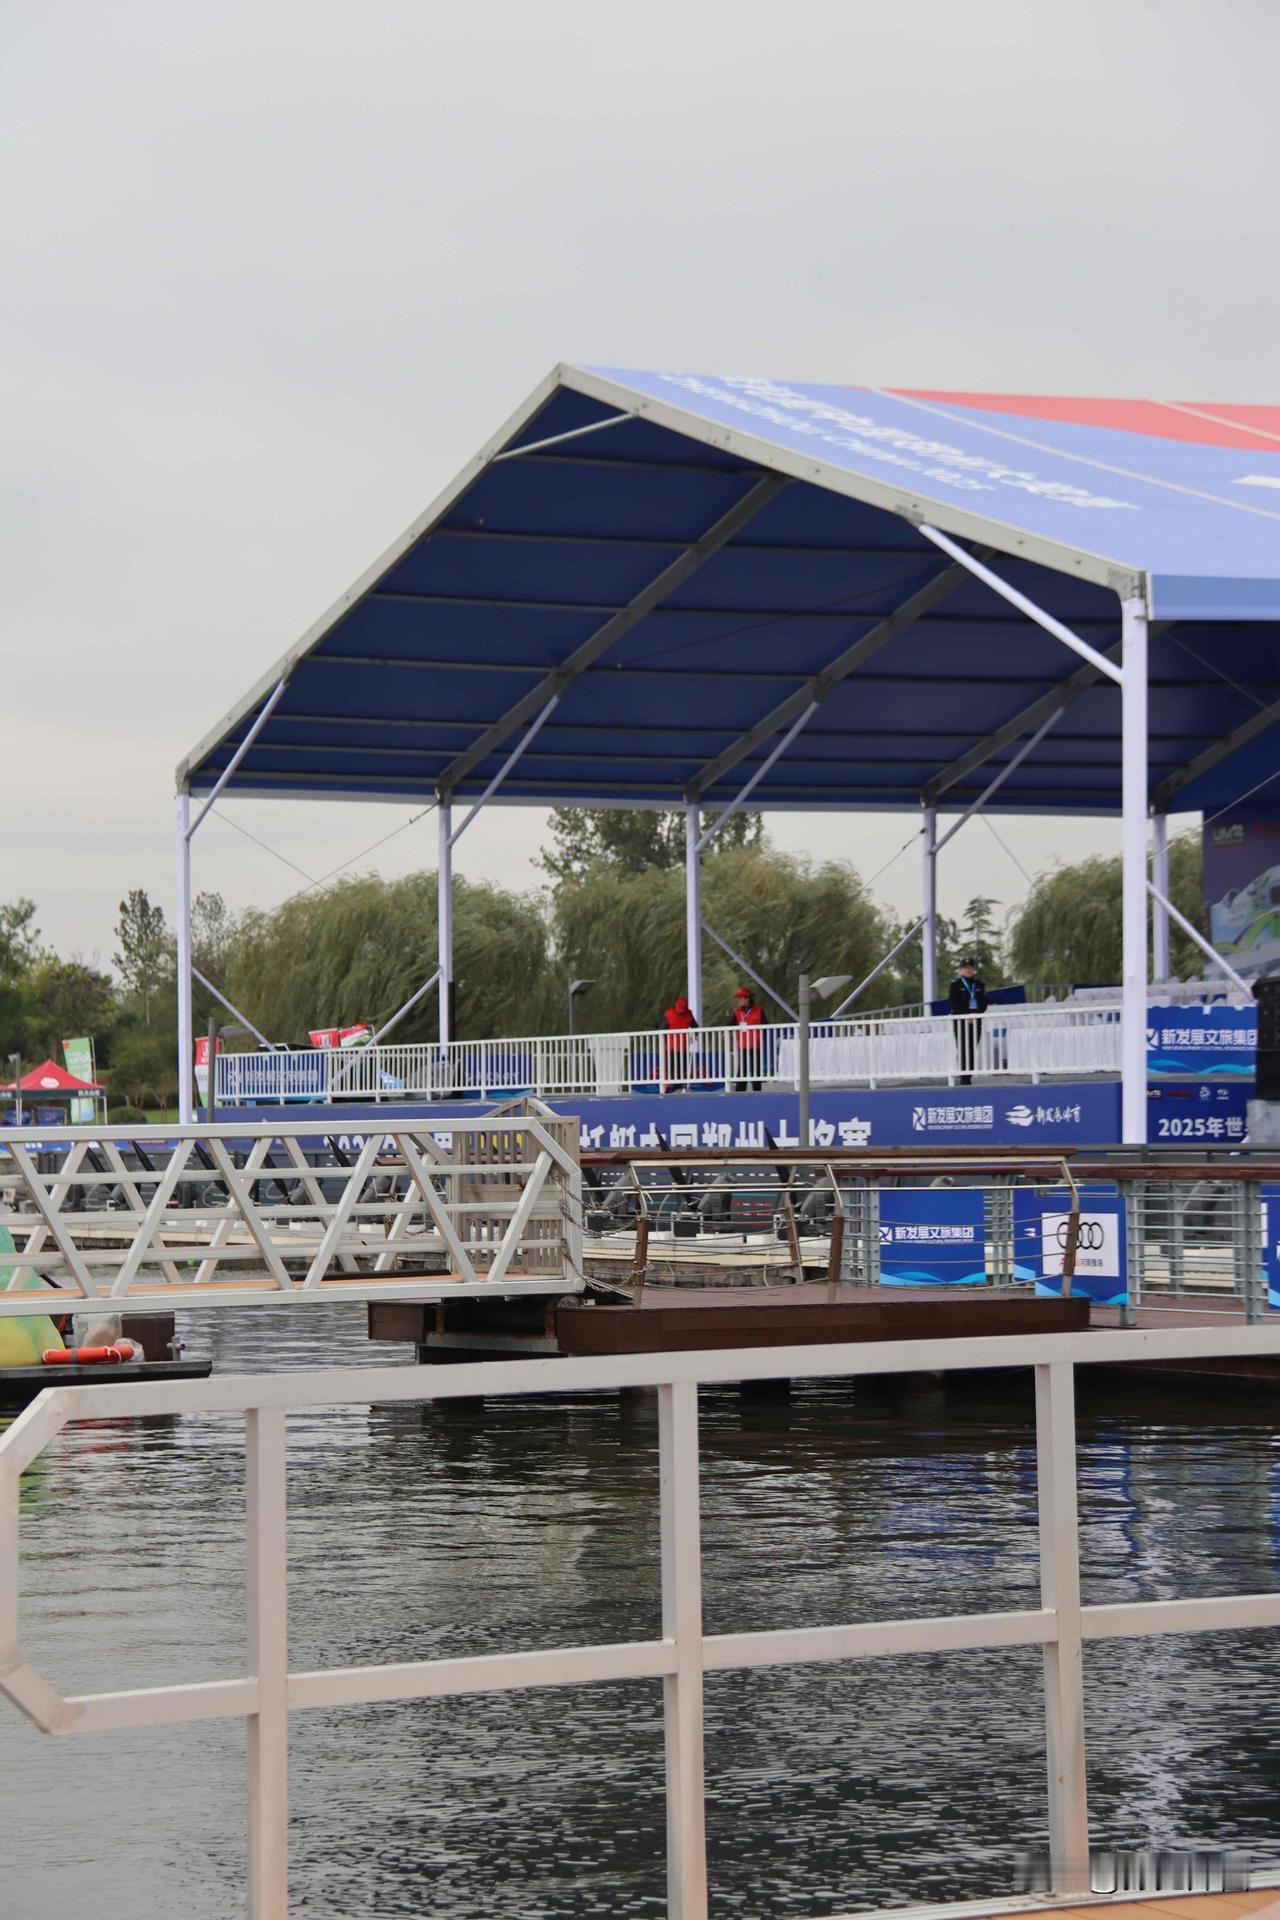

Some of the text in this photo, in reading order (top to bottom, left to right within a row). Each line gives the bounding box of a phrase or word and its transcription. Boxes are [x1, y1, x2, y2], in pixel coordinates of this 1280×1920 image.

[1161, 1028, 1258, 1046] 新发展文旅集团
[927, 1105, 994, 1124] 新发展文旅集团
[1158, 1116, 1249, 1138] 2025年世
